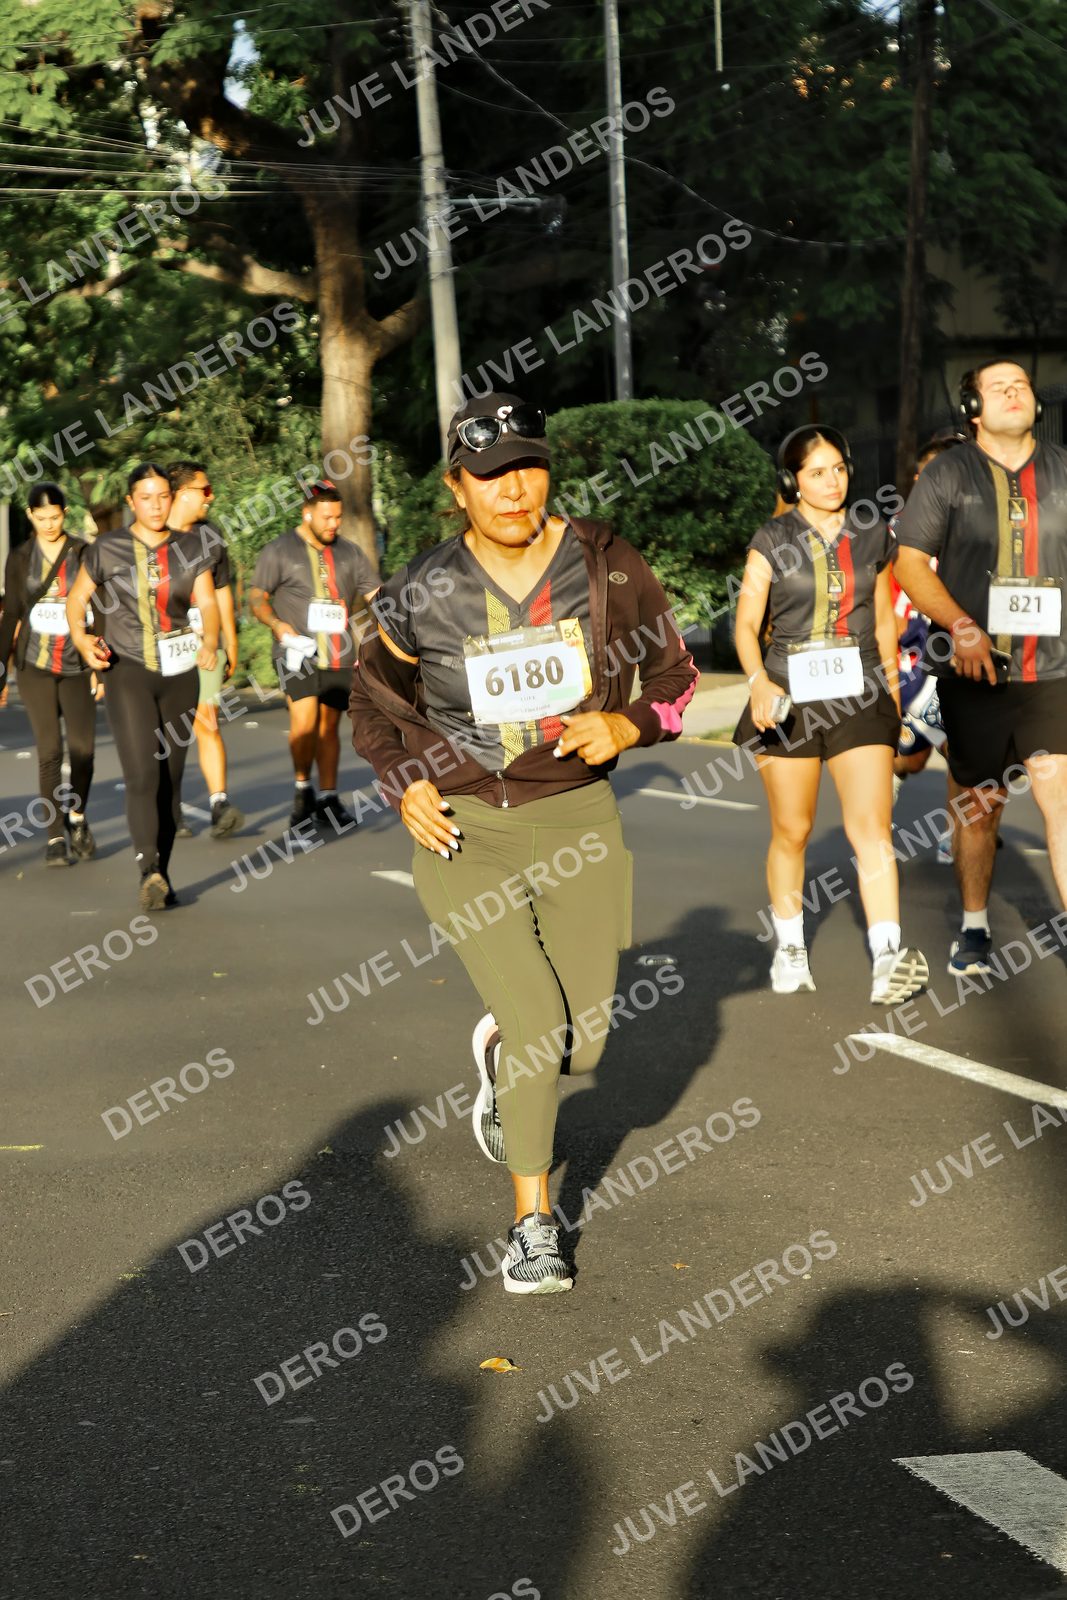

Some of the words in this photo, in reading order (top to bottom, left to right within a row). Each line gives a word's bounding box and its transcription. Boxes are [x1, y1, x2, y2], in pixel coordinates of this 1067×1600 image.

[1009, 594, 1041, 613] 821
[167, 639, 197, 659] 7346
[485, 656, 564, 696] 6180
[808, 656, 844, 678] 818
